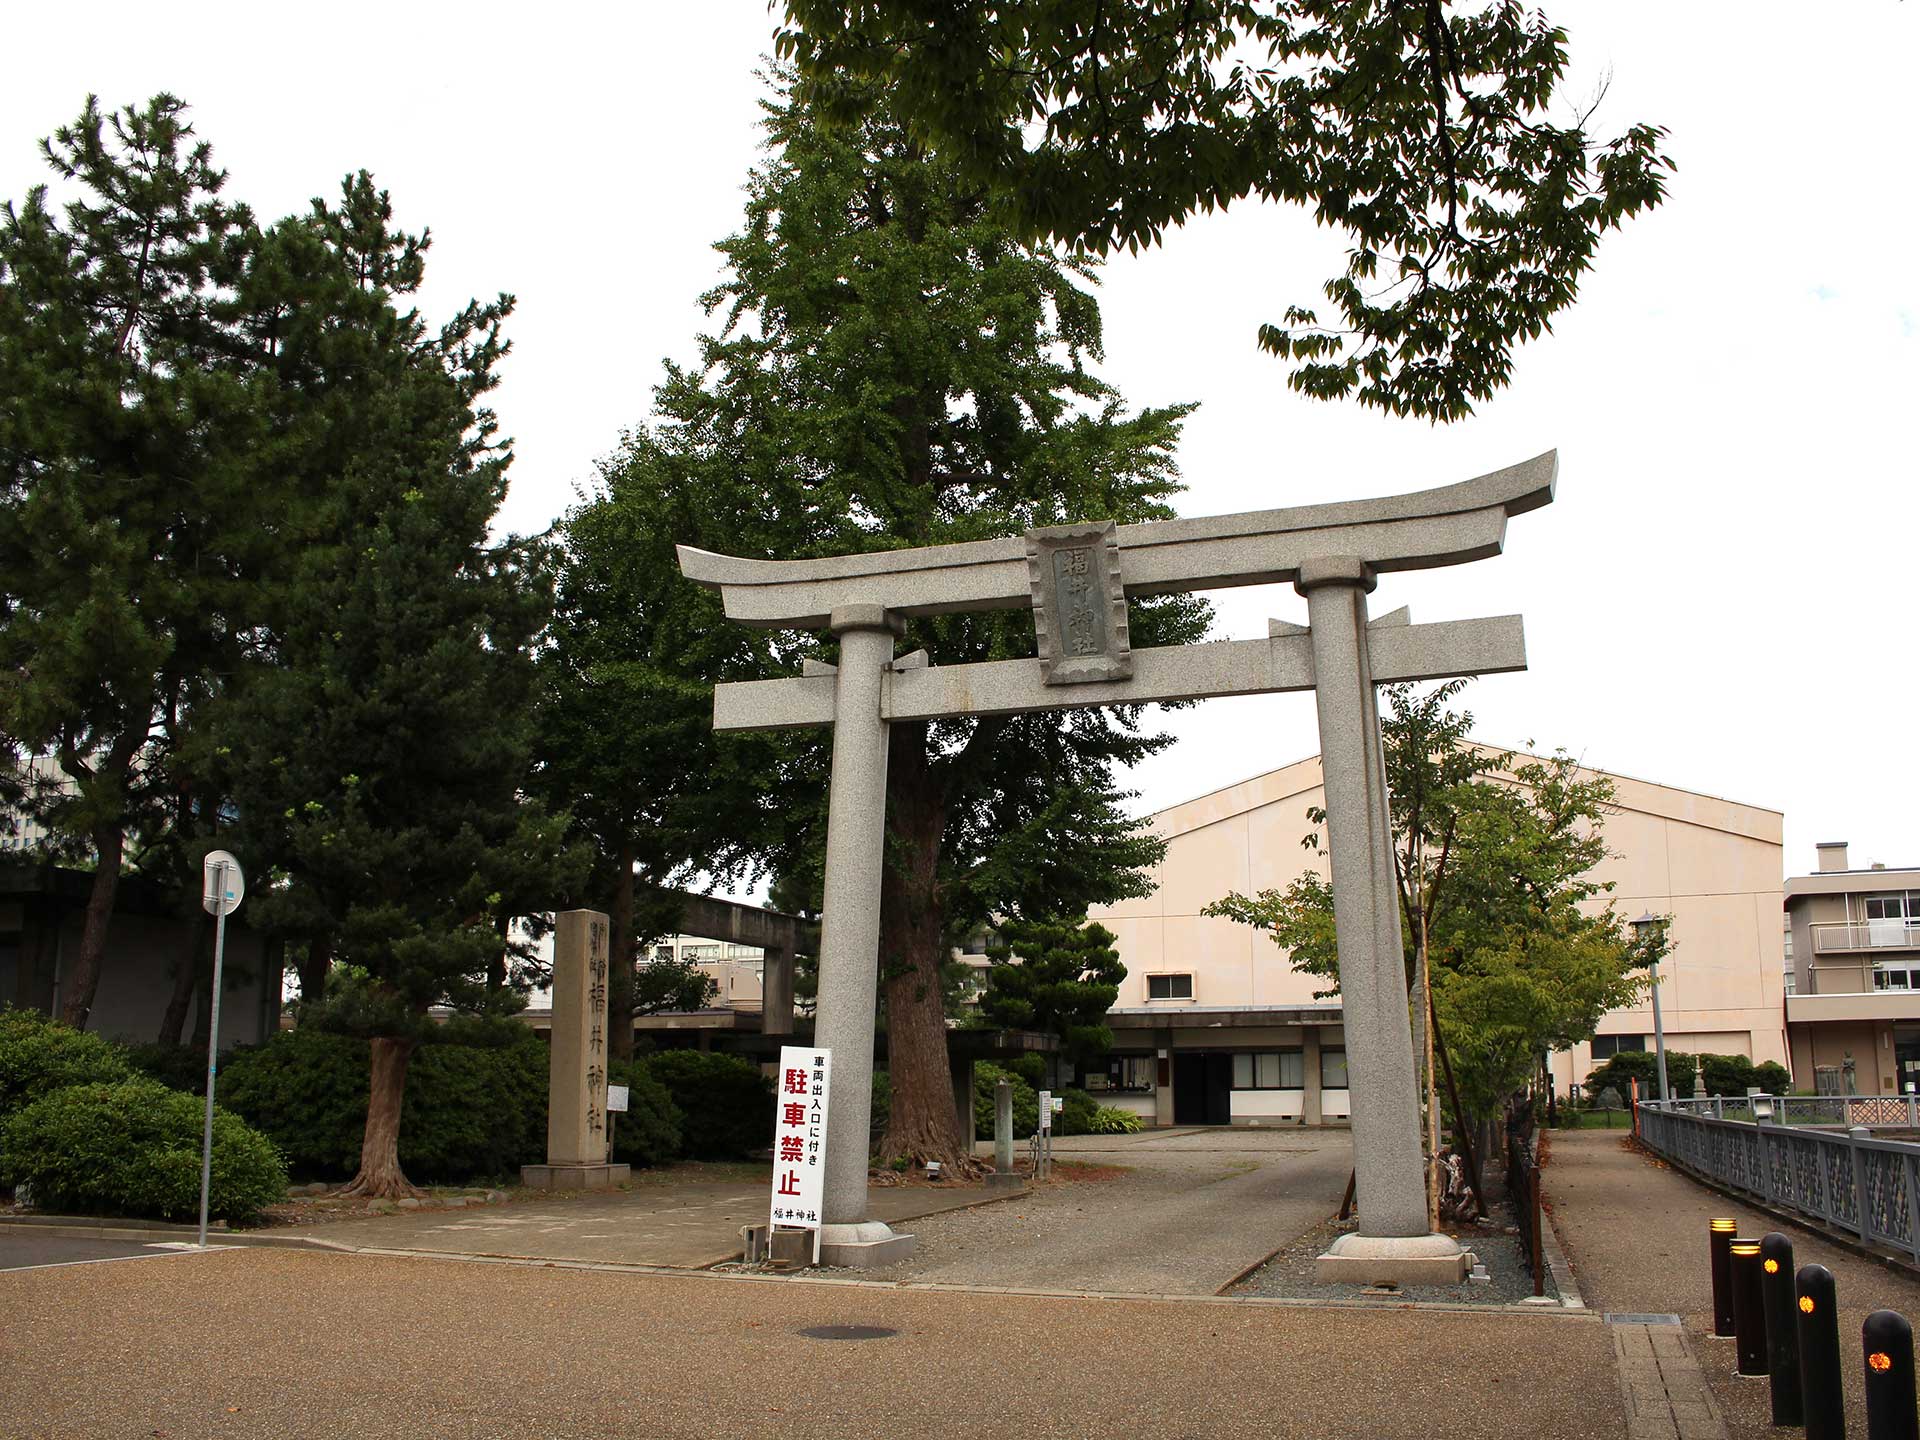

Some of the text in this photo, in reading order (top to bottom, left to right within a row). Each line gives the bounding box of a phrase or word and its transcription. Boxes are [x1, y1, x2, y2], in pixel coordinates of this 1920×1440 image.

[1063, 551, 1098, 655] 福井神社
[587, 983, 605, 1134] 福井神社
[808, 1056, 825, 1166] 車両出入口に付き
[777, 1068, 808, 1196] 駐車禁止
[773, 1207, 817, 1222] 福井神社
